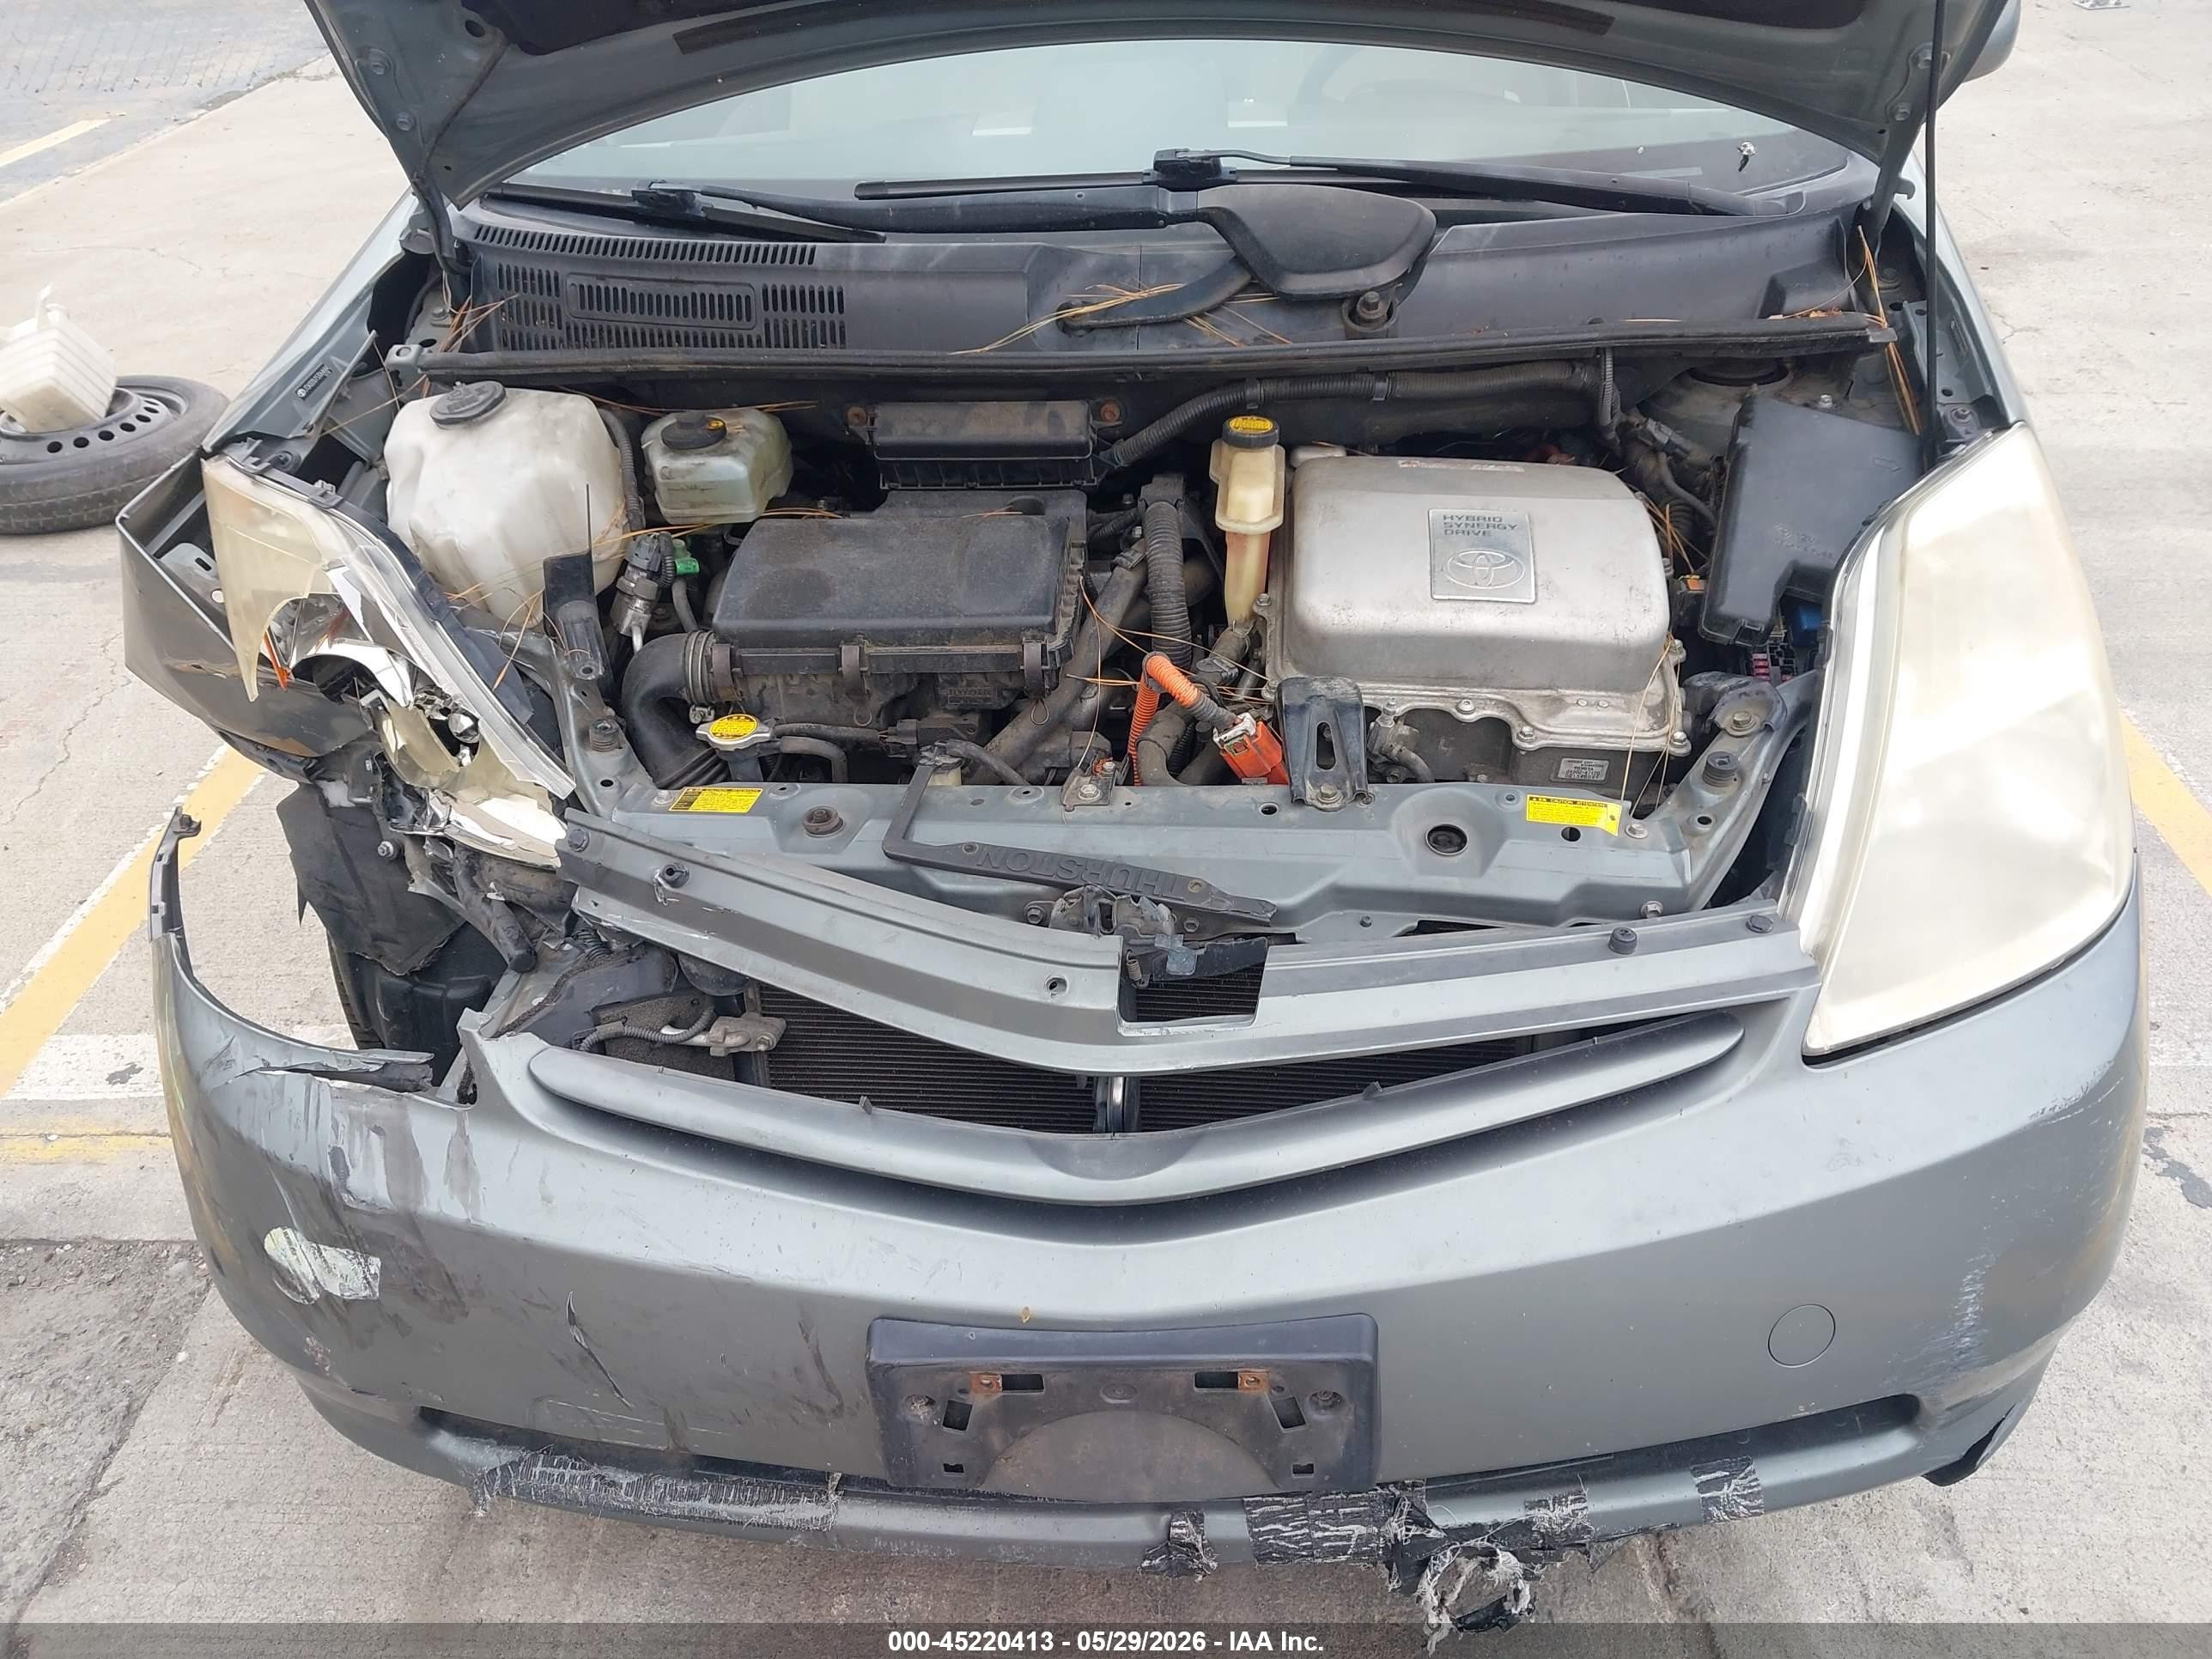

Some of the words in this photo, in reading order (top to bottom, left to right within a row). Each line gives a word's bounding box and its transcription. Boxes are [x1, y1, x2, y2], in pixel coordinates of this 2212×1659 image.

[1443, 514, 1503, 523] HYBRID
[1443, 521, 1517, 530] SYNERGY
[976, 851, 1186, 901] THURSTON
